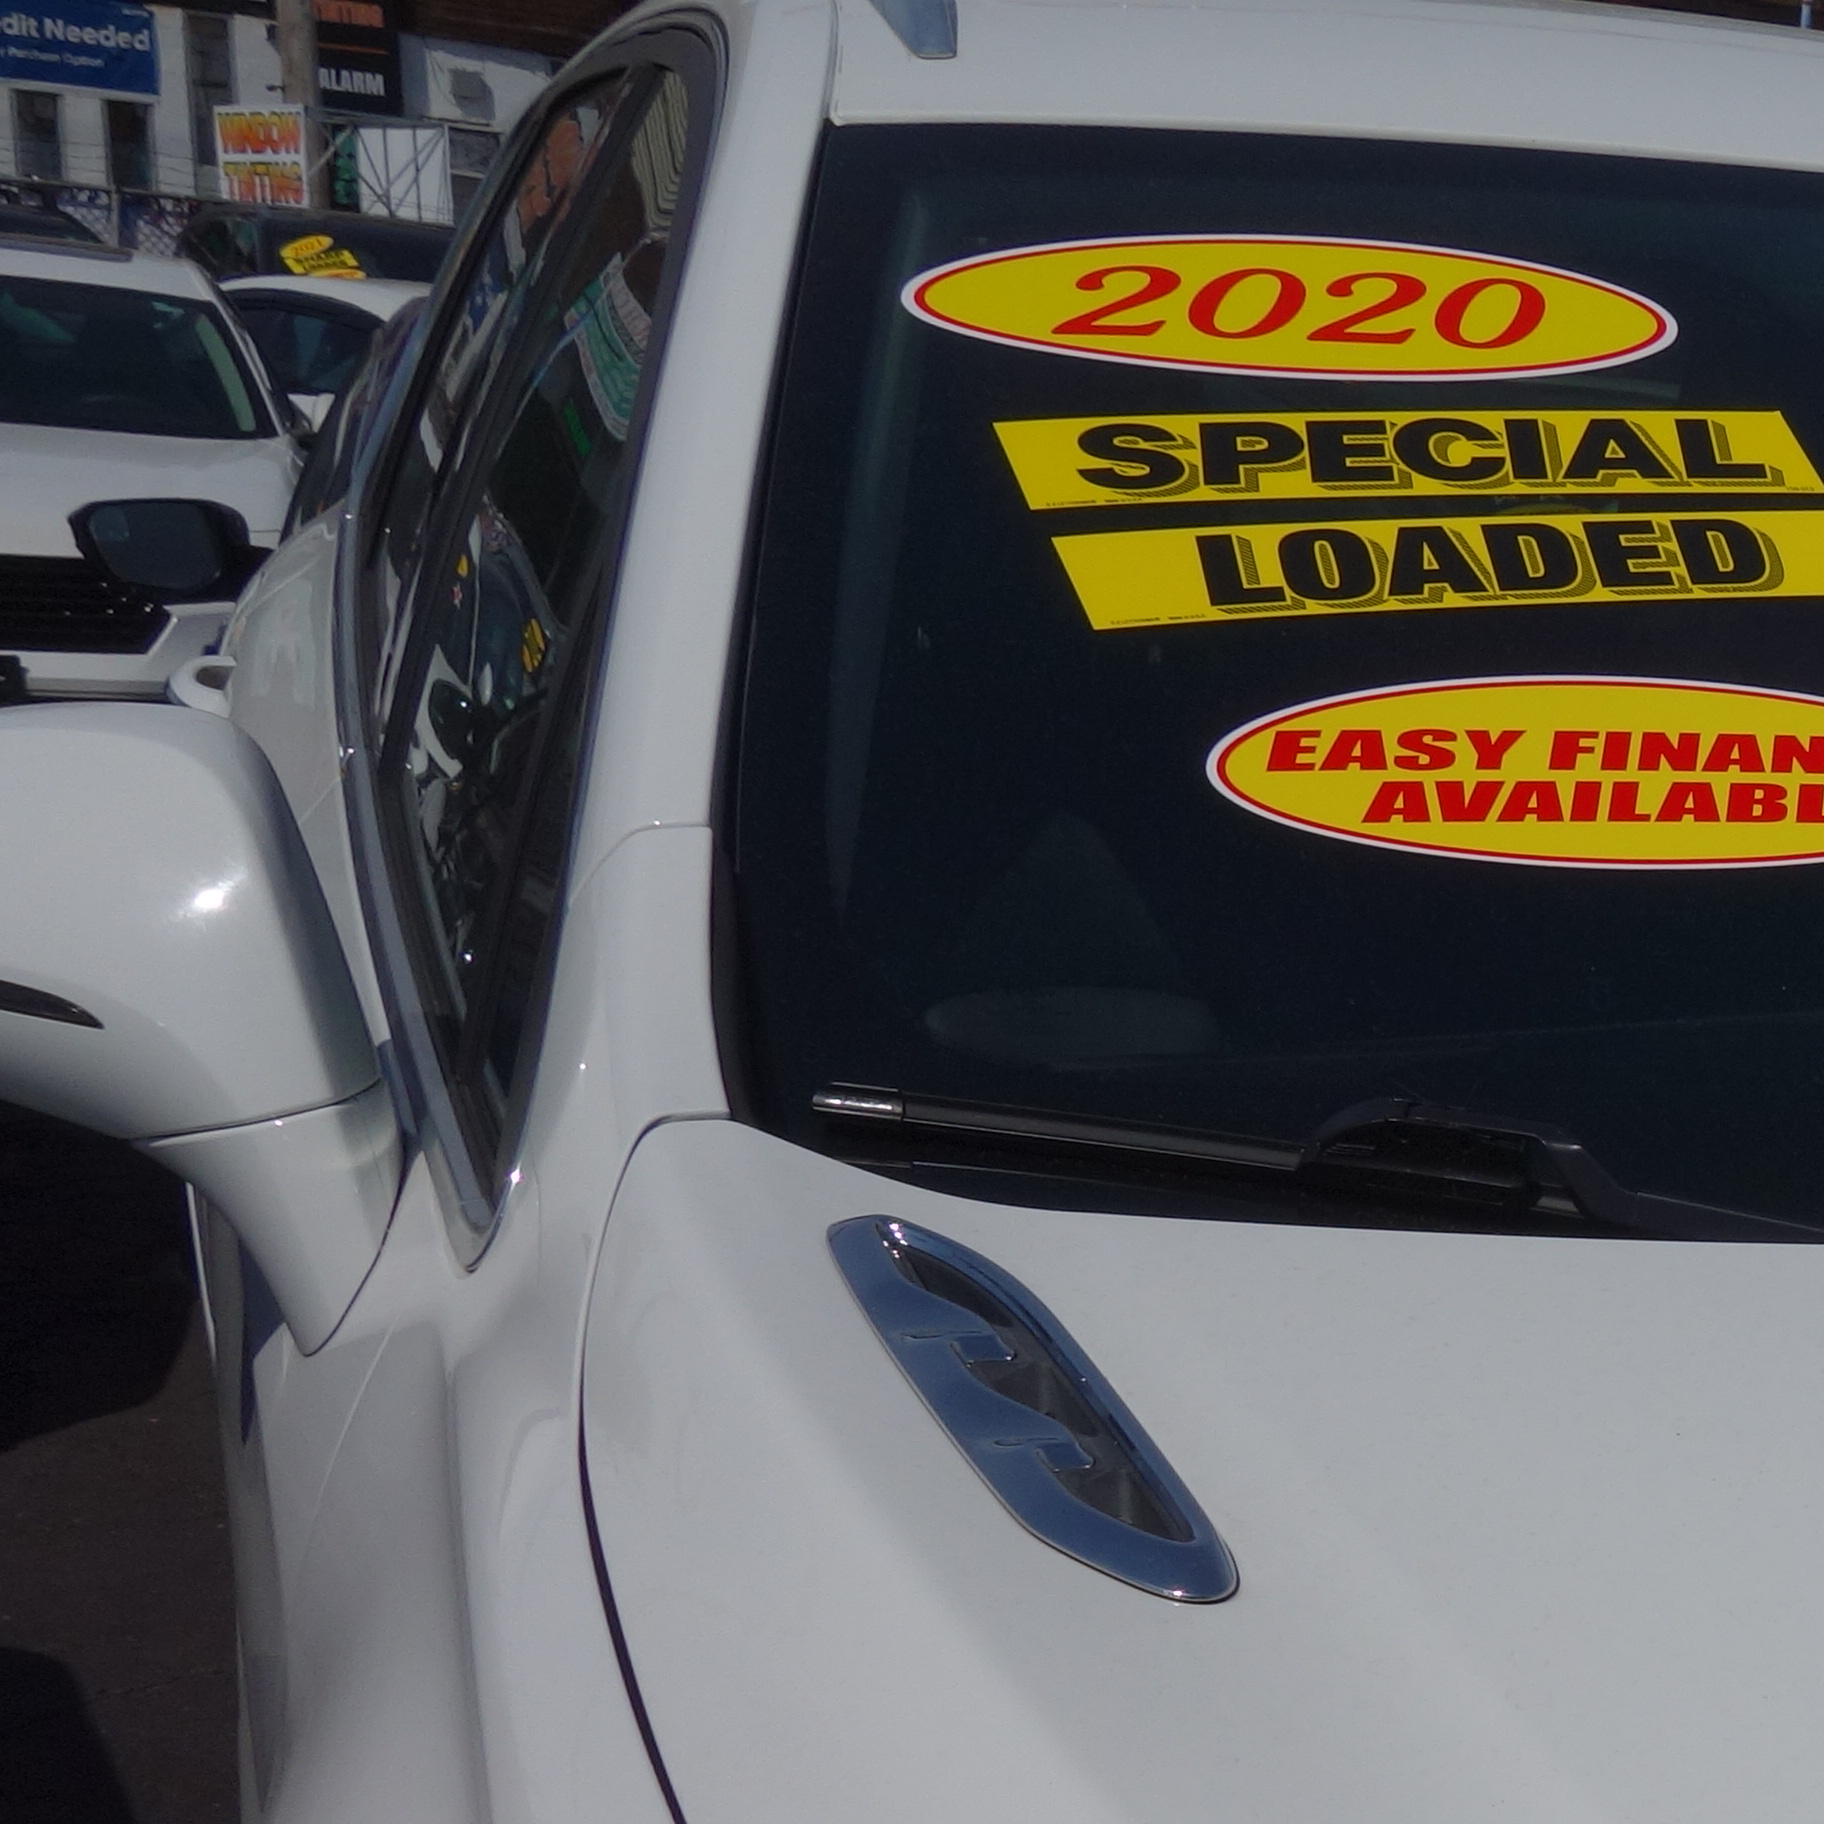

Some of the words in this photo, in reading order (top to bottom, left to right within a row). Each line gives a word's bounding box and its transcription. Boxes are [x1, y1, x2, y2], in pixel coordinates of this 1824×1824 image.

[0, 13, 39, 38] dit
[43, 17, 149, 51] Needed
[318, 66, 386, 97] ALARM
[1050, 264, 1546, 349] 2020
[1075, 416, 1778, 494] SPECIAL
[1195, 517, 1778, 610] LOADED
[1266, 728, 1526, 772] EASY
